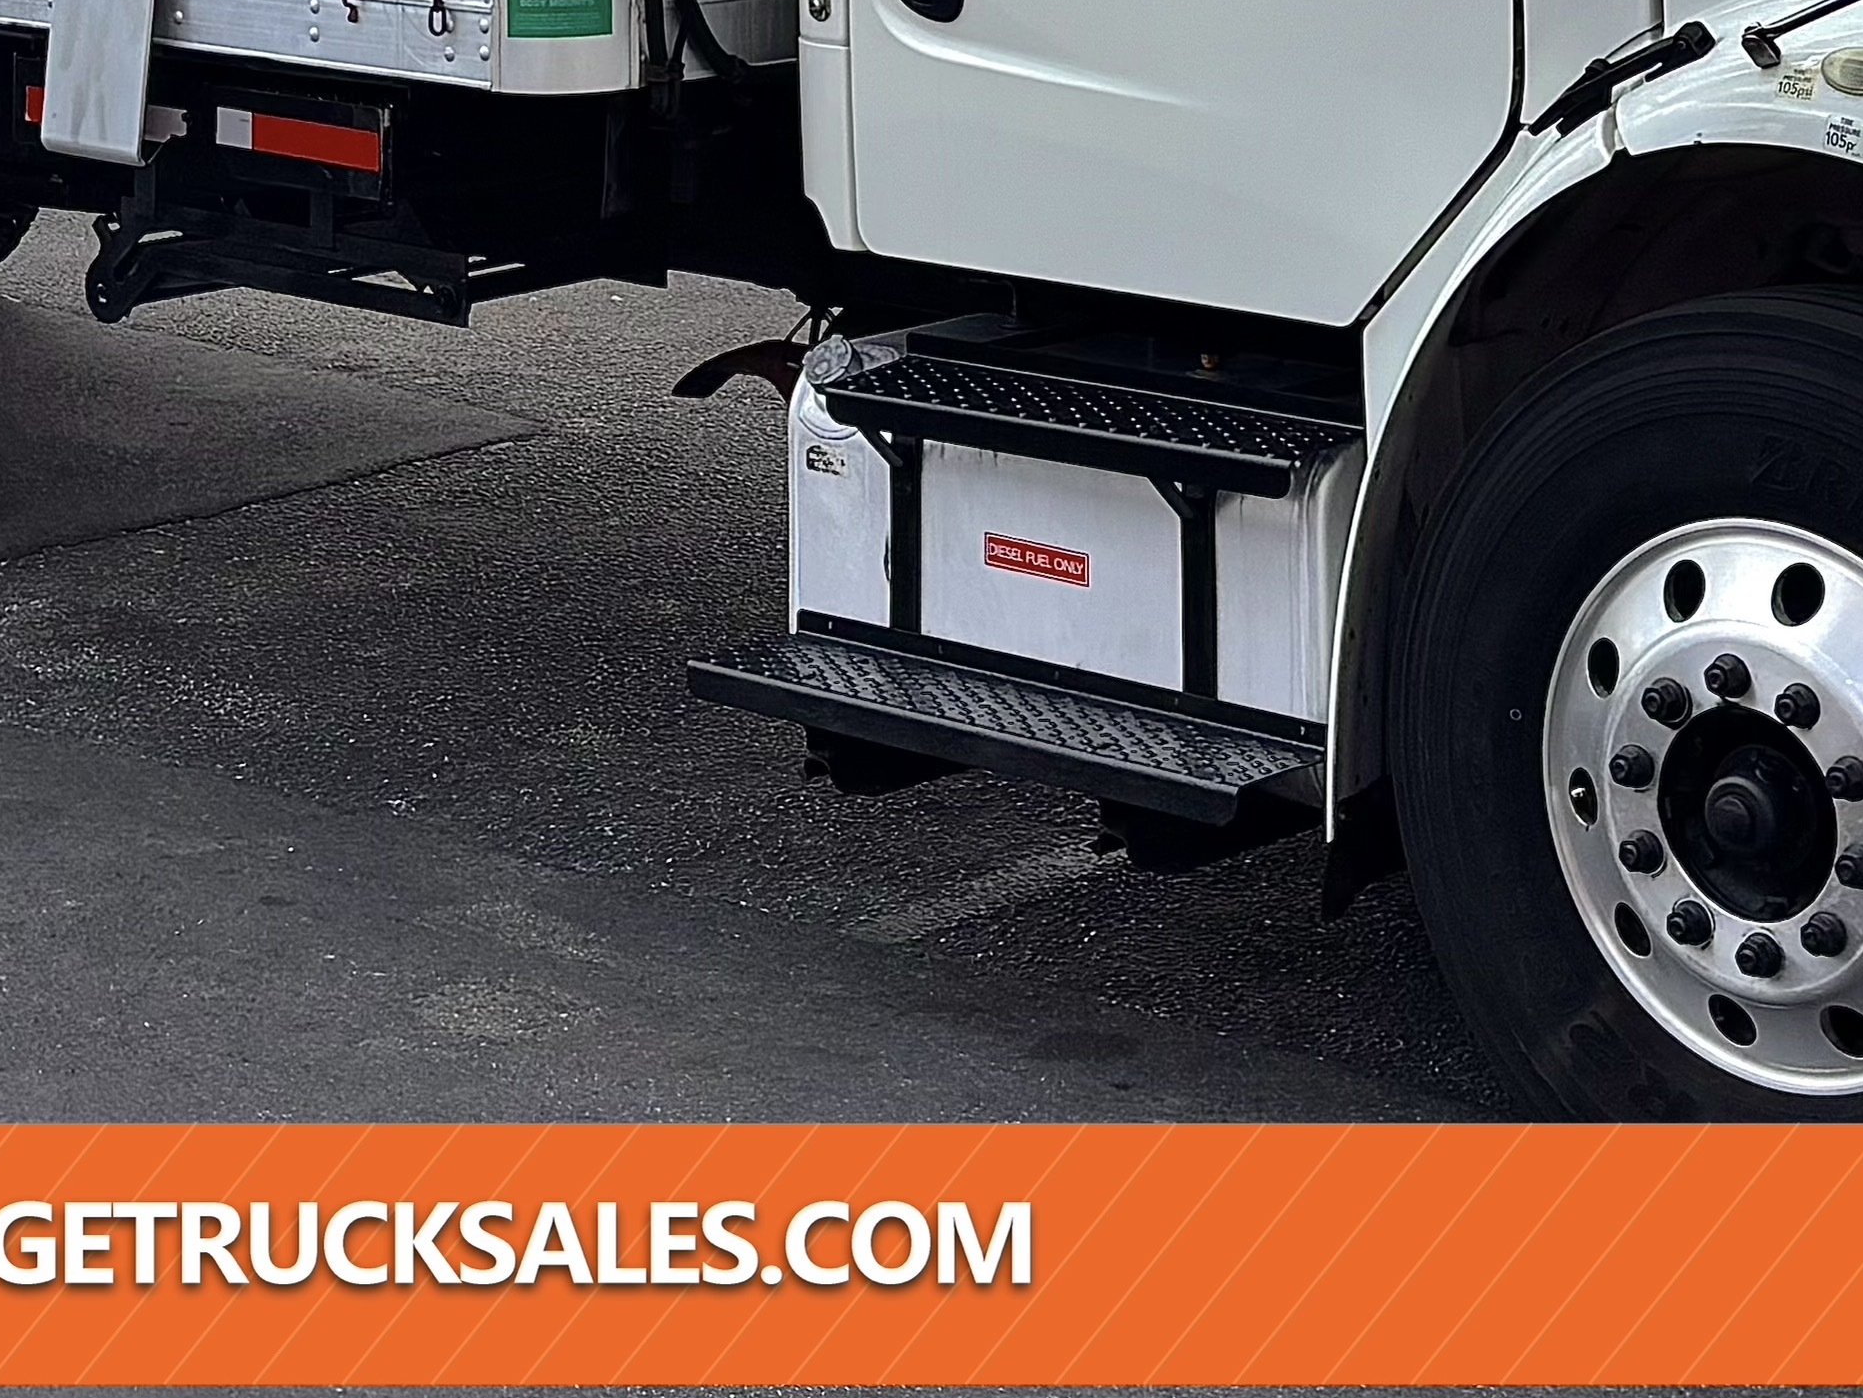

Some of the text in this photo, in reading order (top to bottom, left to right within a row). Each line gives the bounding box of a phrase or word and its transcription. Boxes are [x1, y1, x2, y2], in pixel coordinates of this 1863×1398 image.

[989, 542, 1084, 574] DIESEL FUEL ONLY
